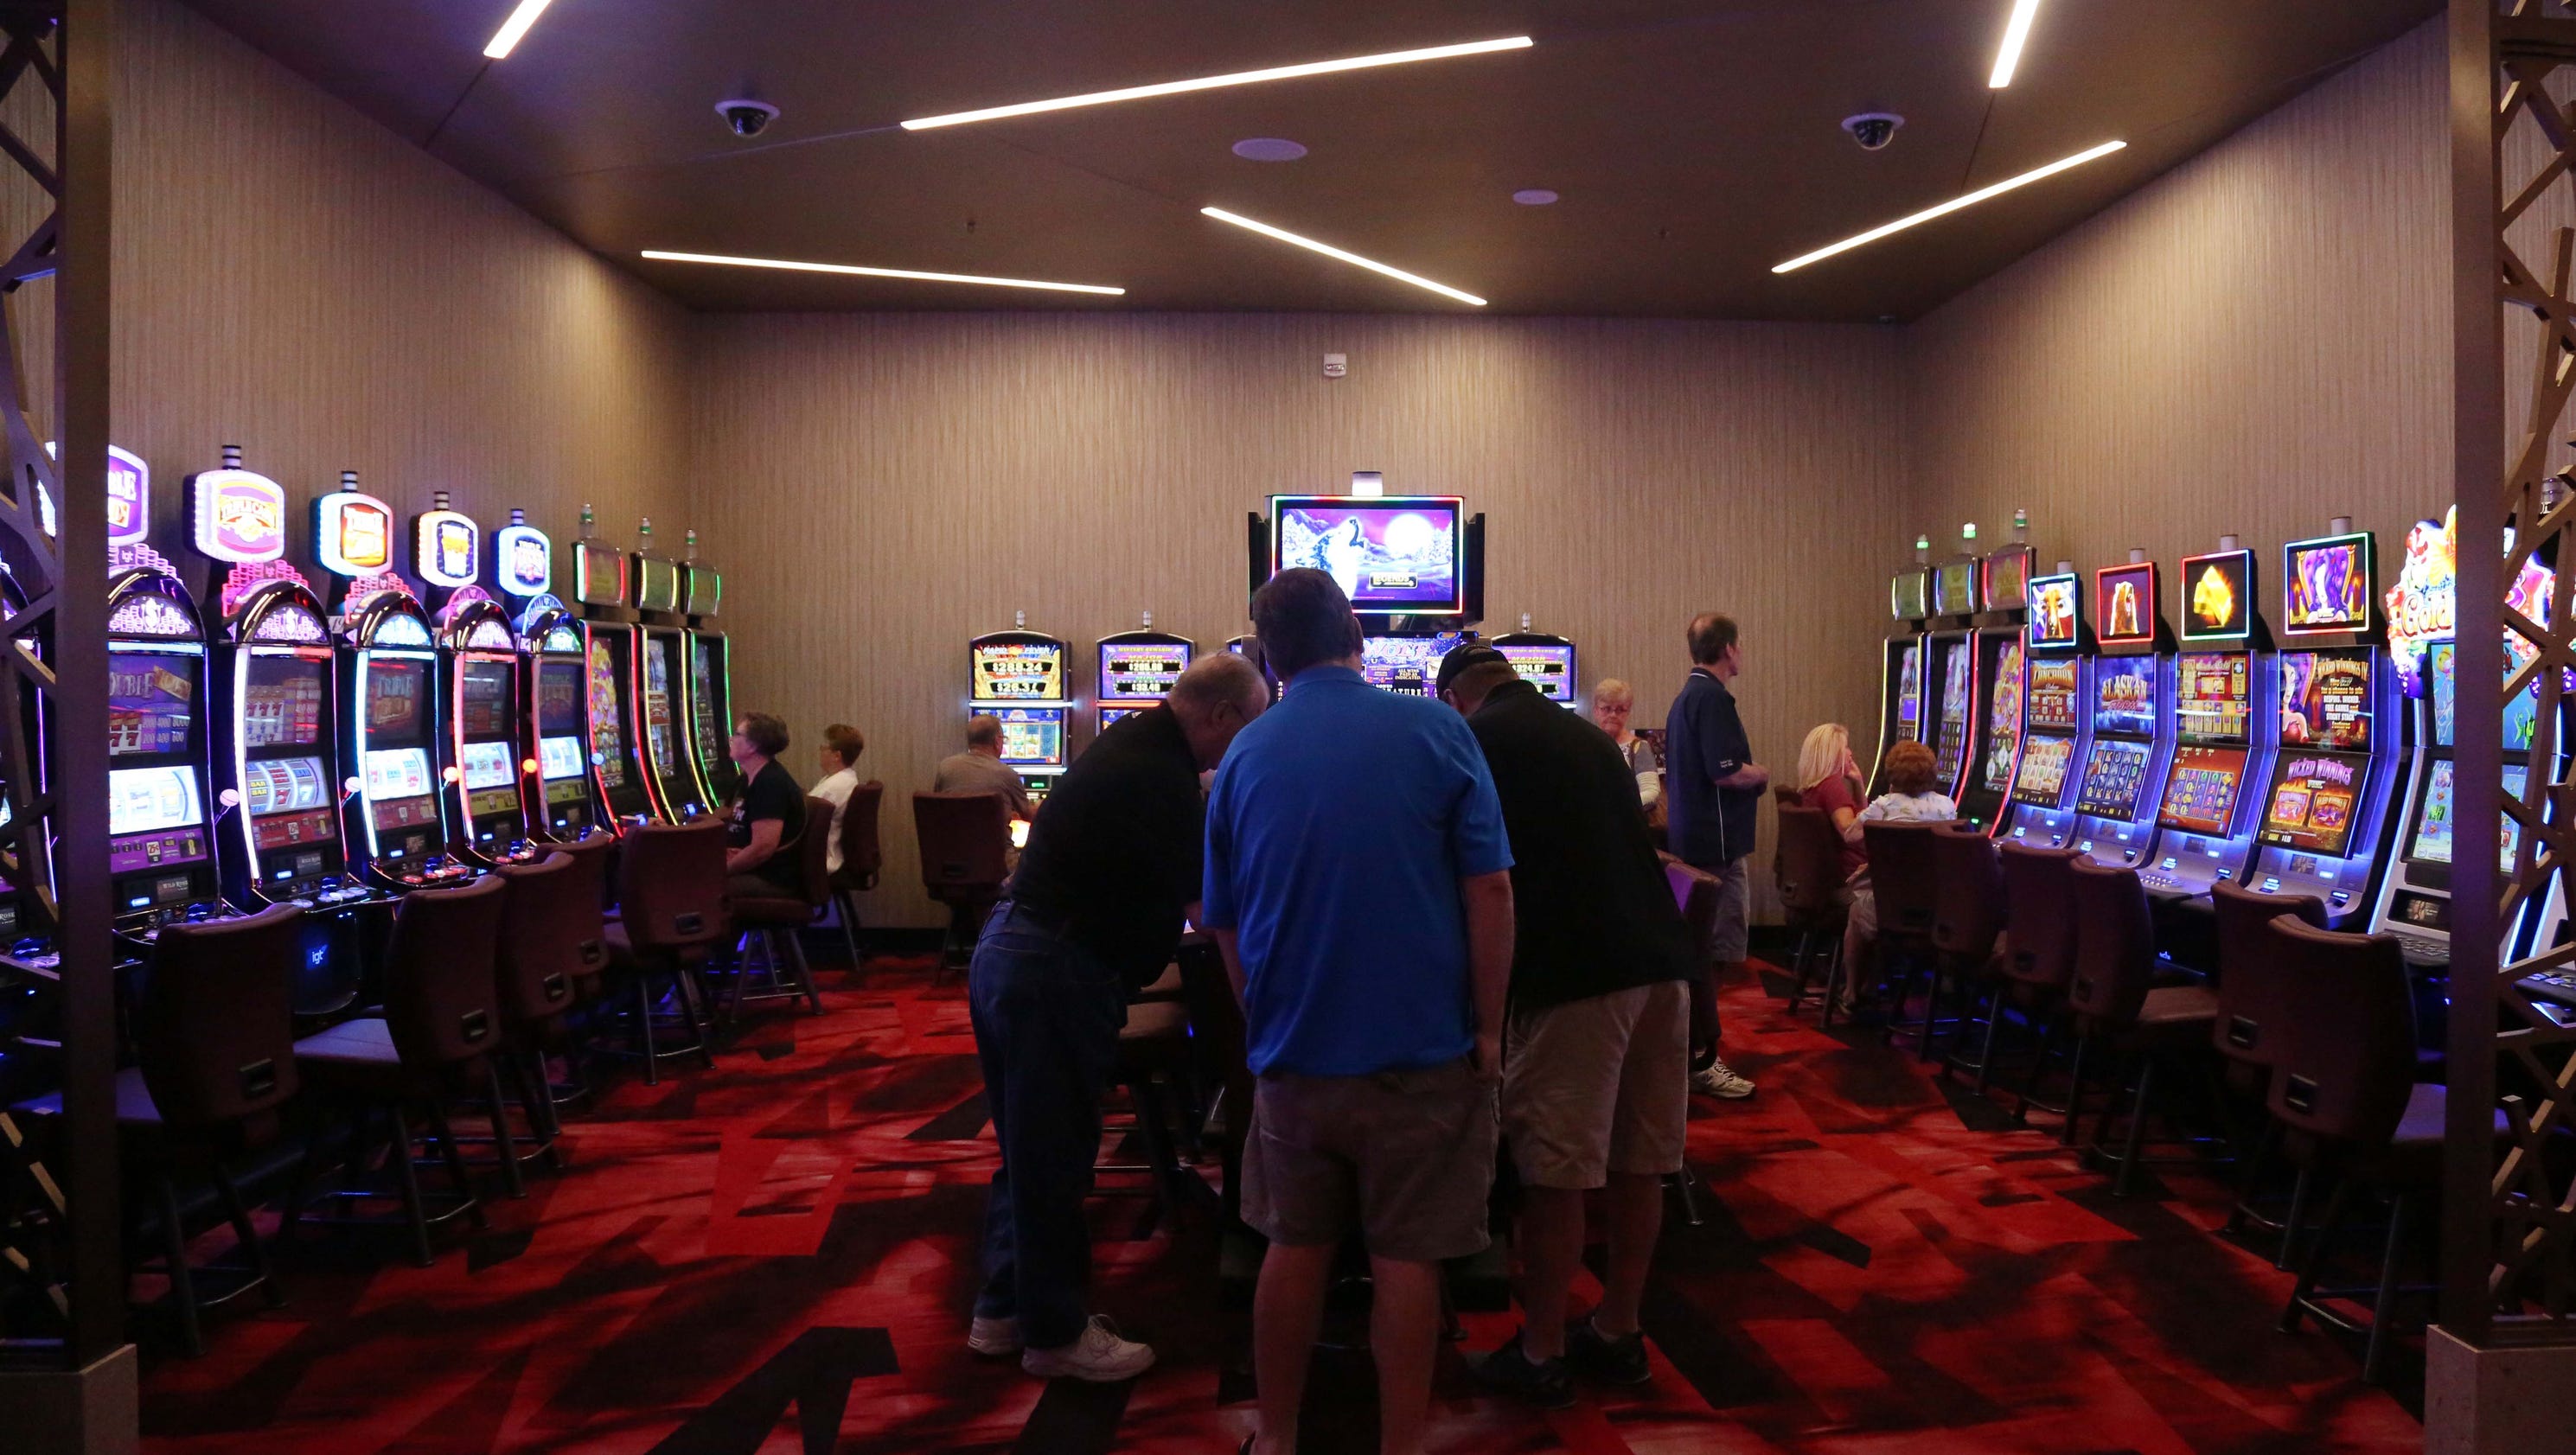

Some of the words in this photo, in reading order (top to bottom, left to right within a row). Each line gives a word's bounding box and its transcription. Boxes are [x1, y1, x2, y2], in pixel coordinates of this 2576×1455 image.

[2402, 590, 2453, 637] Gold
[109, 672, 155, 699] OUBLE
[2102, 673, 2147, 701] ALASKAN
[2287, 758, 2316, 781] WICKED
[2317, 758, 2355, 786] WINNINGS
[311, 949, 324, 965] igt
